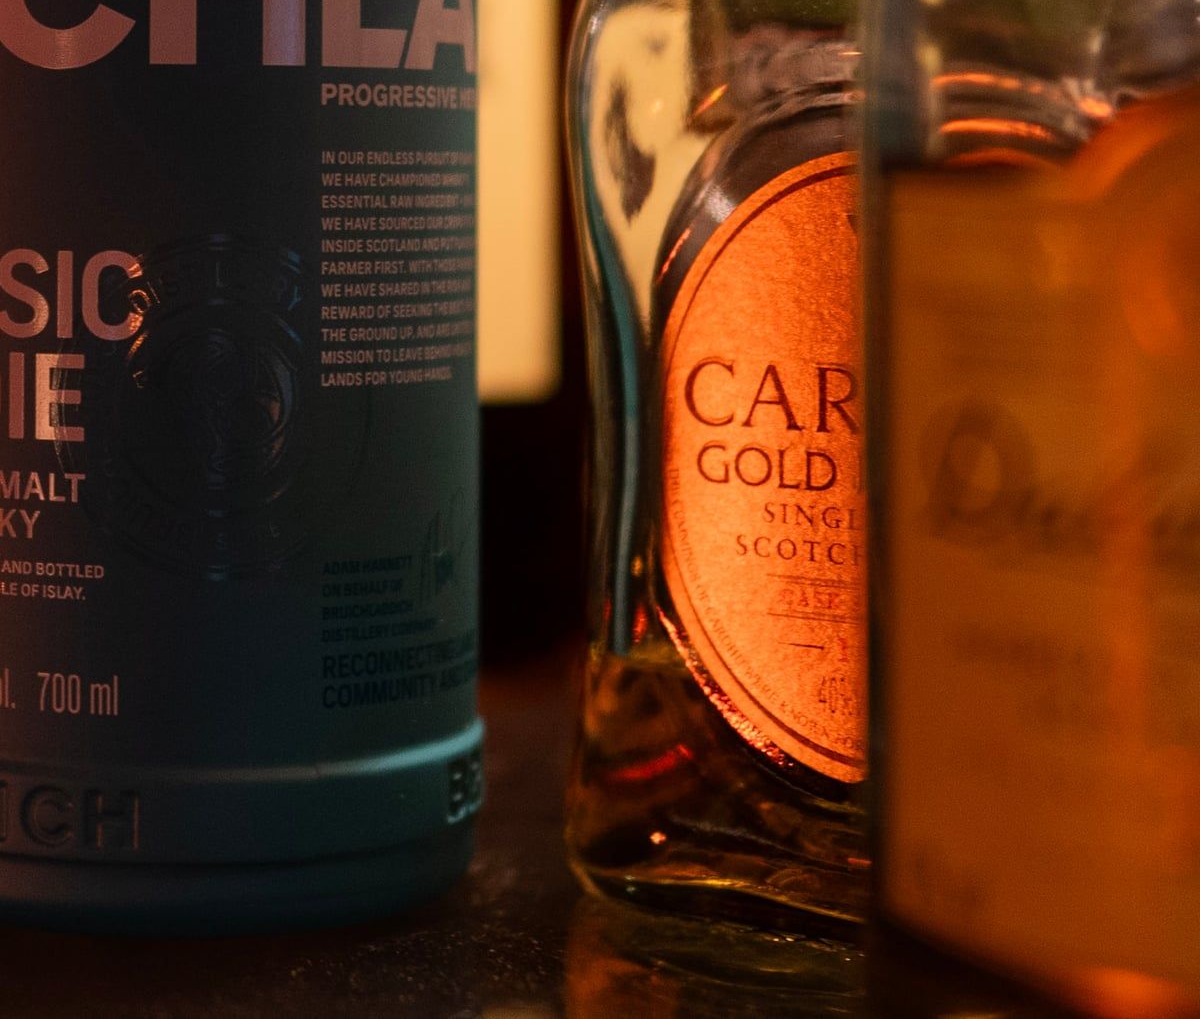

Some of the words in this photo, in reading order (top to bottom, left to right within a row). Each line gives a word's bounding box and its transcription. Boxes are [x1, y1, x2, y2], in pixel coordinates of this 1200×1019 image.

[320, 83, 457, 109] PROGRESSIVE
[321, 151, 335, 165] IN
[338, 151, 364, 165] OUR
[367, 151, 414, 166] ENDLESS
[321, 172, 342, 187] WE
[345, 172, 377, 187] HAVE
[321, 195, 388, 209] ESSENTIAL
[390, 195, 414, 209] RAW
[321, 217, 342, 231] WE
[344, 217, 377, 231] HAVE
[379, 216, 425, 231] SOURCED
[321, 239, 366, 253] INSIDE
[366, 238, 421, 253] SCOTLAND
[321, 261, 373, 276] FARMER
[321, 283, 342, 298] WE
[344, 283, 377, 298] HAVE
[378, 282, 420, 297] SHARED
[321, 306, 374, 320] REWARD
[377, 305, 391, 319] OF
[321, 328, 347, 342] THE
[350, 327, 398, 342] GROUND
[321, 350, 374, 365] MISSION
[377, 349, 392, 363] TO
[321, 372, 363, 387] LANDS
[365, 370, 388, 386] FOR
[684, 355, 862, 434] CAR
[697, 443, 838, 492] GOLD
[1, 560, 32, 576] AND
[35, 562, 105, 579] BOTTLED
[21, 582, 40, 598] OF
[42, 583, 86, 601] ISLAY.
[36, 671, 81, 715] 700
[90, 674, 120, 717] ml
